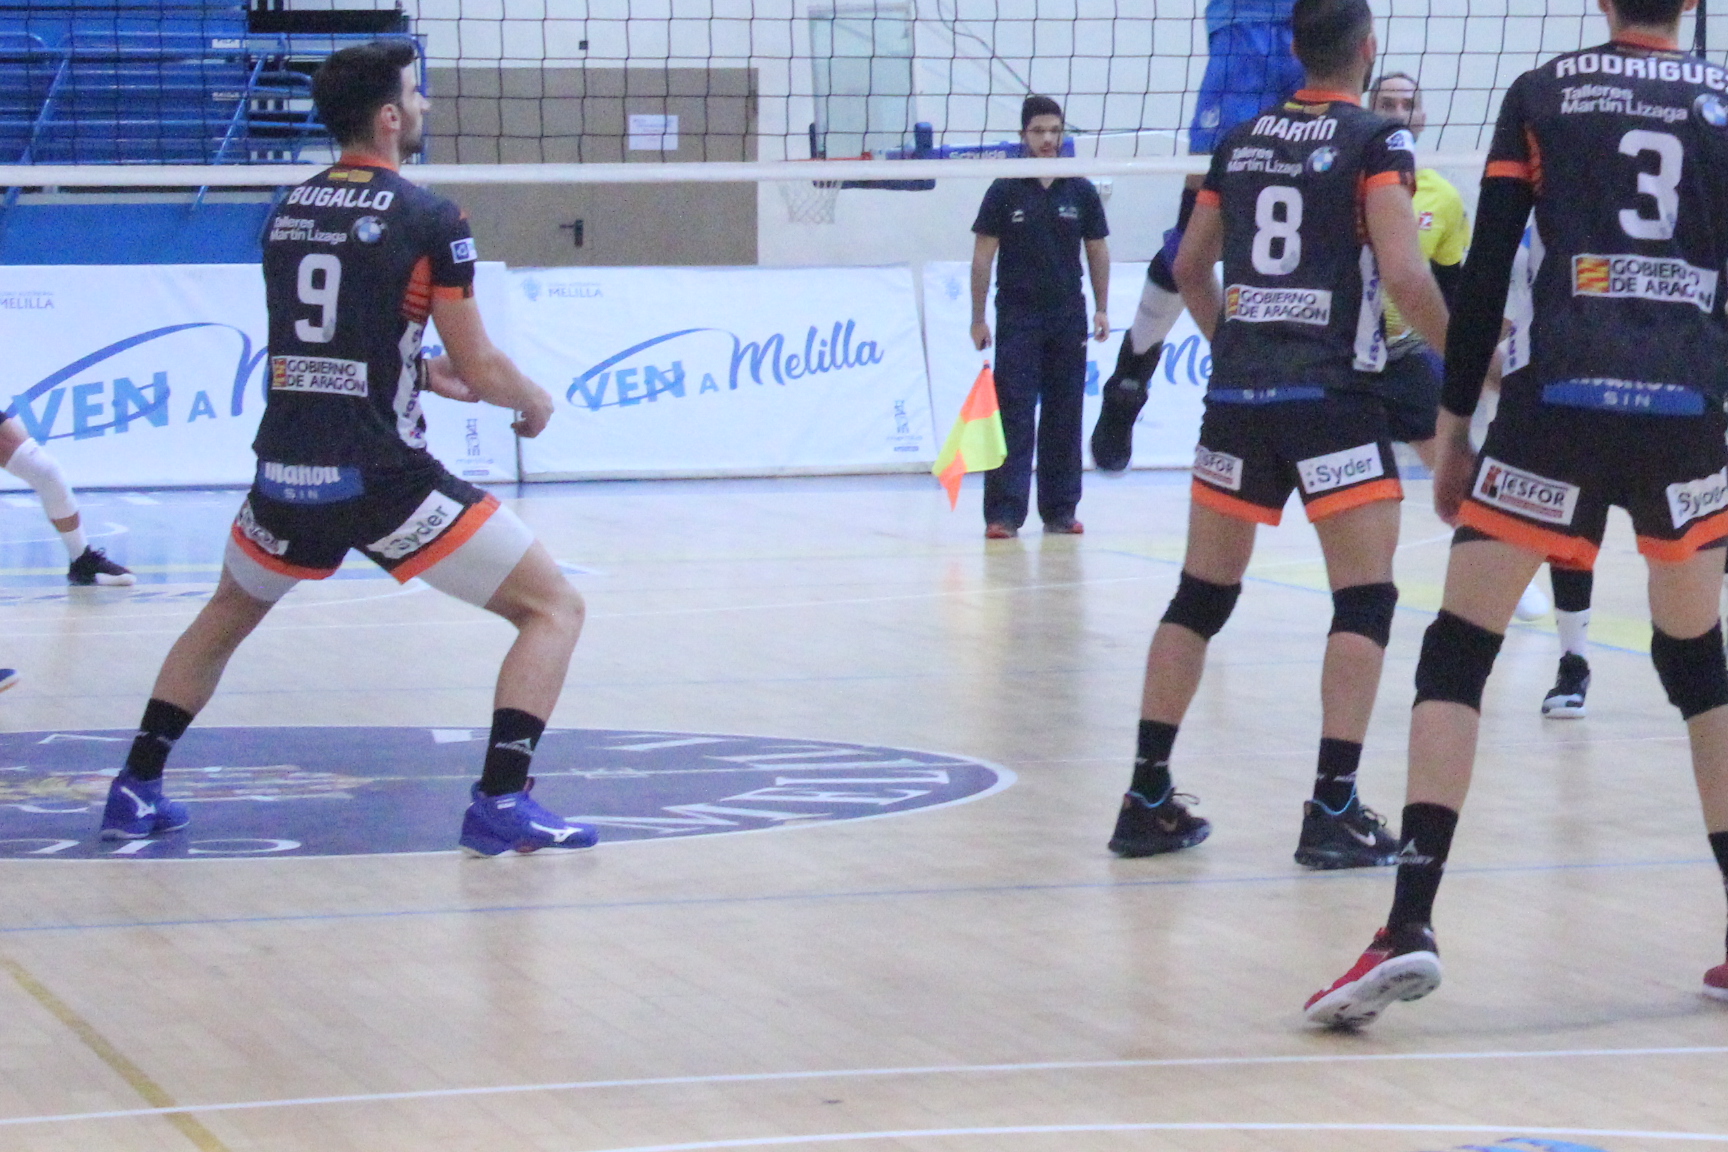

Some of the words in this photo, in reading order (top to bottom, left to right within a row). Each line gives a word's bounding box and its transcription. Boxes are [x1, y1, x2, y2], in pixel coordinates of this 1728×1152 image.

[1561, 84, 1634, 101] Talleres
[1625, 98, 1688, 123] Lizaga
[1618, 129, 1683, 241] 3
[287, 186, 394, 211] BUGALLO
[307, 228, 347, 245] Lizaga
[1251, 185, 1304, 276] 8
[548, 288, 603, 298] MELILLA
[1612, 277, 1638, 292] DE
[295, 253, 342, 343] 9
[1240, 290, 1316, 305] GOBIERNO
[1238, 303, 1258, 318] DE
[287, 359, 357, 377] GOBIERNO
[573, 360, 686, 412] VEN
[700, 373, 719, 394] A
[729, 318, 884, 391] Melilla
[287, 375, 304, 388] DE
[11, 371, 170, 446] VEN
[187, 390, 217, 423] A
[1315, 457, 1373, 485] Syder
